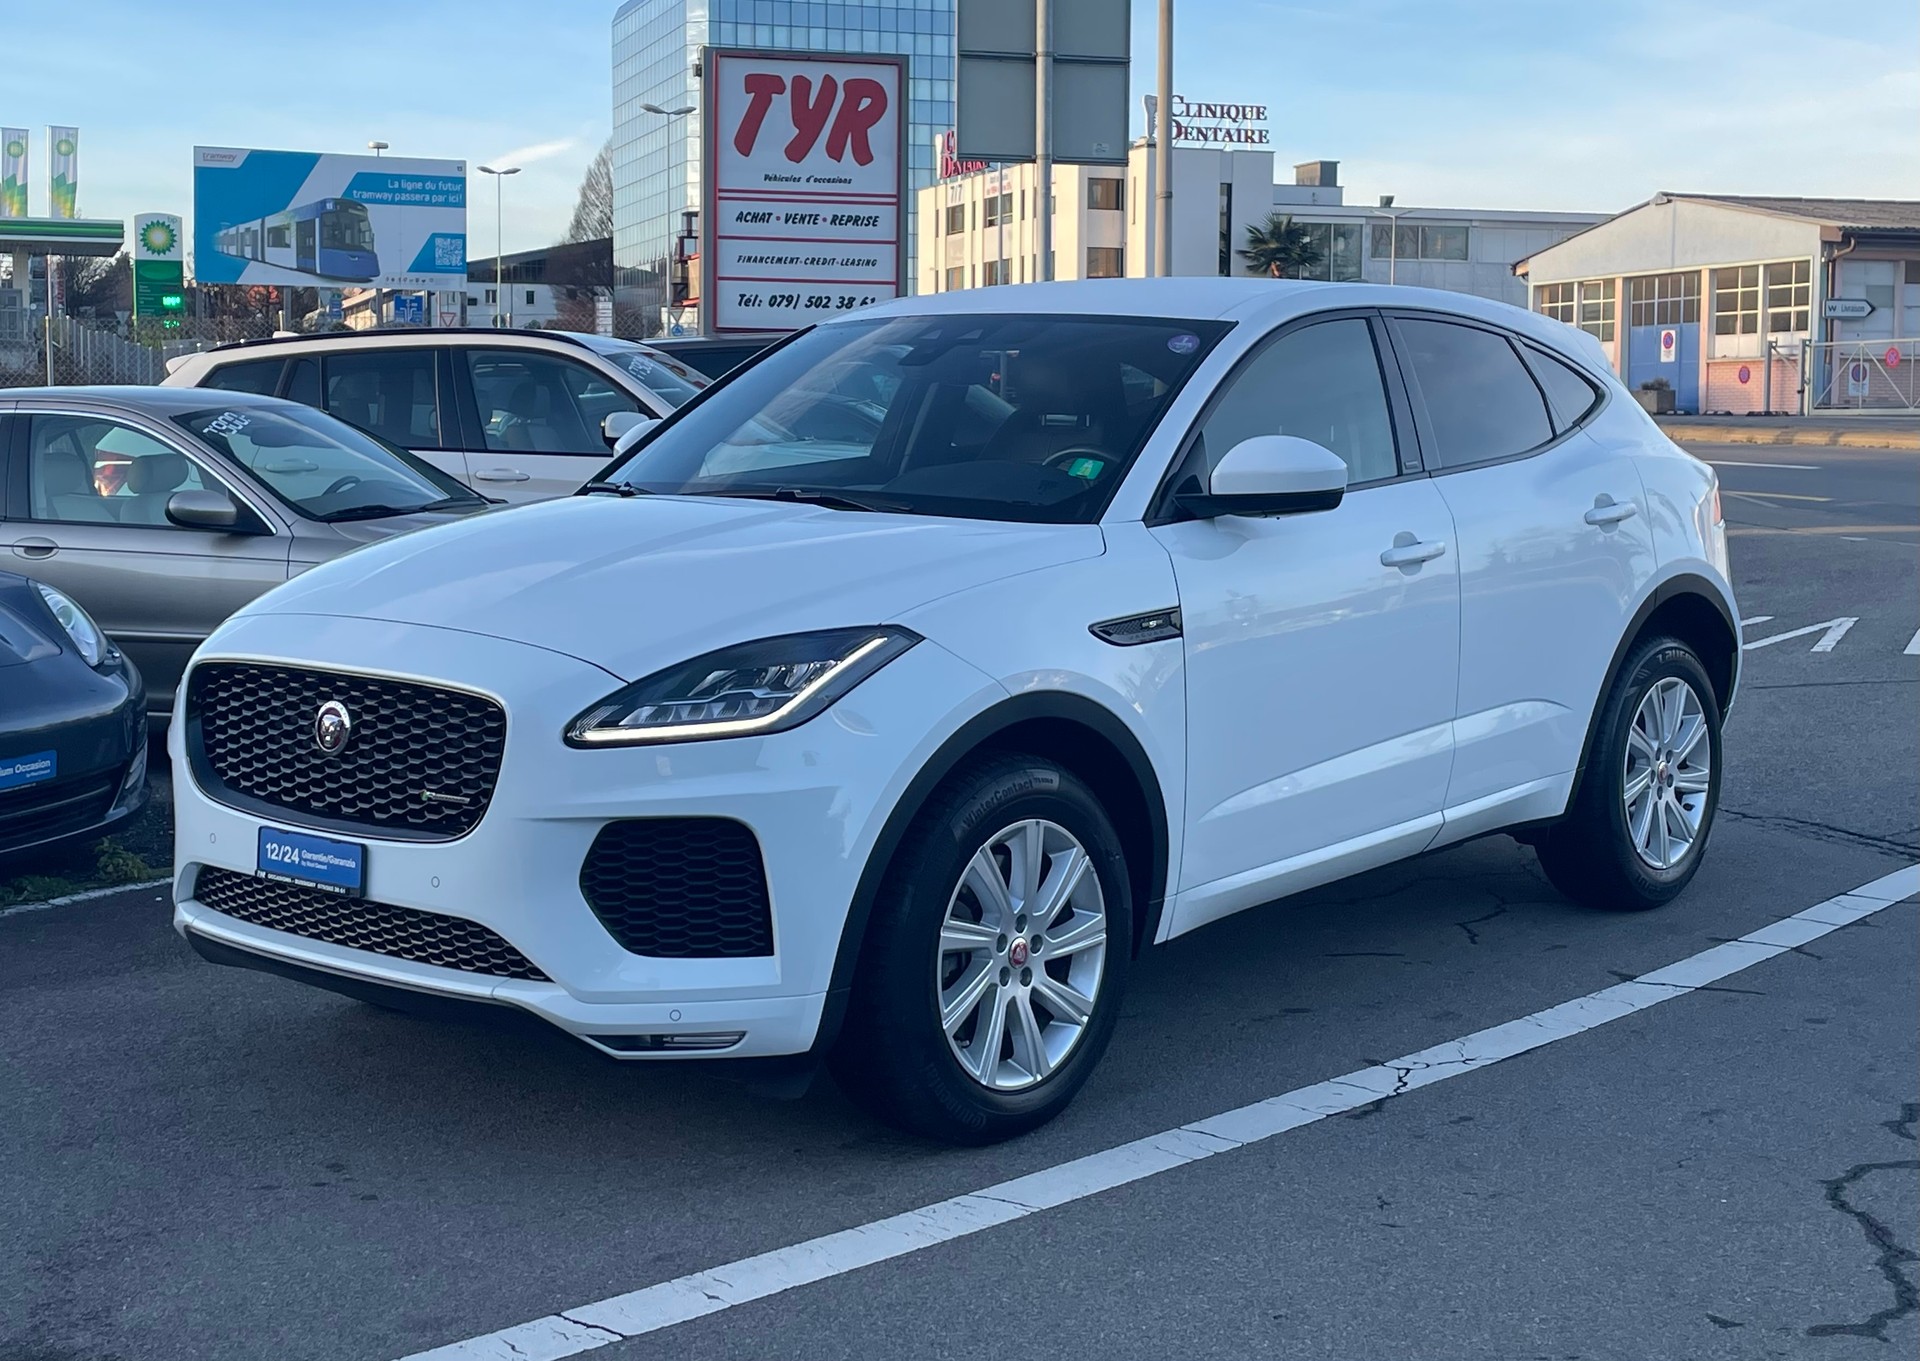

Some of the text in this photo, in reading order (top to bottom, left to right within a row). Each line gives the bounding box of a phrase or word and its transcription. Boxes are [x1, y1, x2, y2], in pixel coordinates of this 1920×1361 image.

[1172, 95, 1267, 123] CLINIQUE
[734, 73, 888, 166] TYR
[388, 179, 462, 191] La ligne du futur
[764, 174, 852, 185] Véhicules d'occasions
[352, 190, 392, 201] tramway
[394, 193, 430, 202] passera
[432, 194, 446, 204] par
[736, 211, 880, 227] ACHAT VENTE REPRISE
[736, 255, 878, 267] FINANCEMENT CREDIT LEASING
[738, 293, 763, 308] Tél:
[805, 296, 832, 309] 502
[836, 296, 856, 310] 38
[14, 759, 51, 774] Occasion
[962, 779, 1034, 828] WinterContact
[265, 842, 300, 864] 12/24
